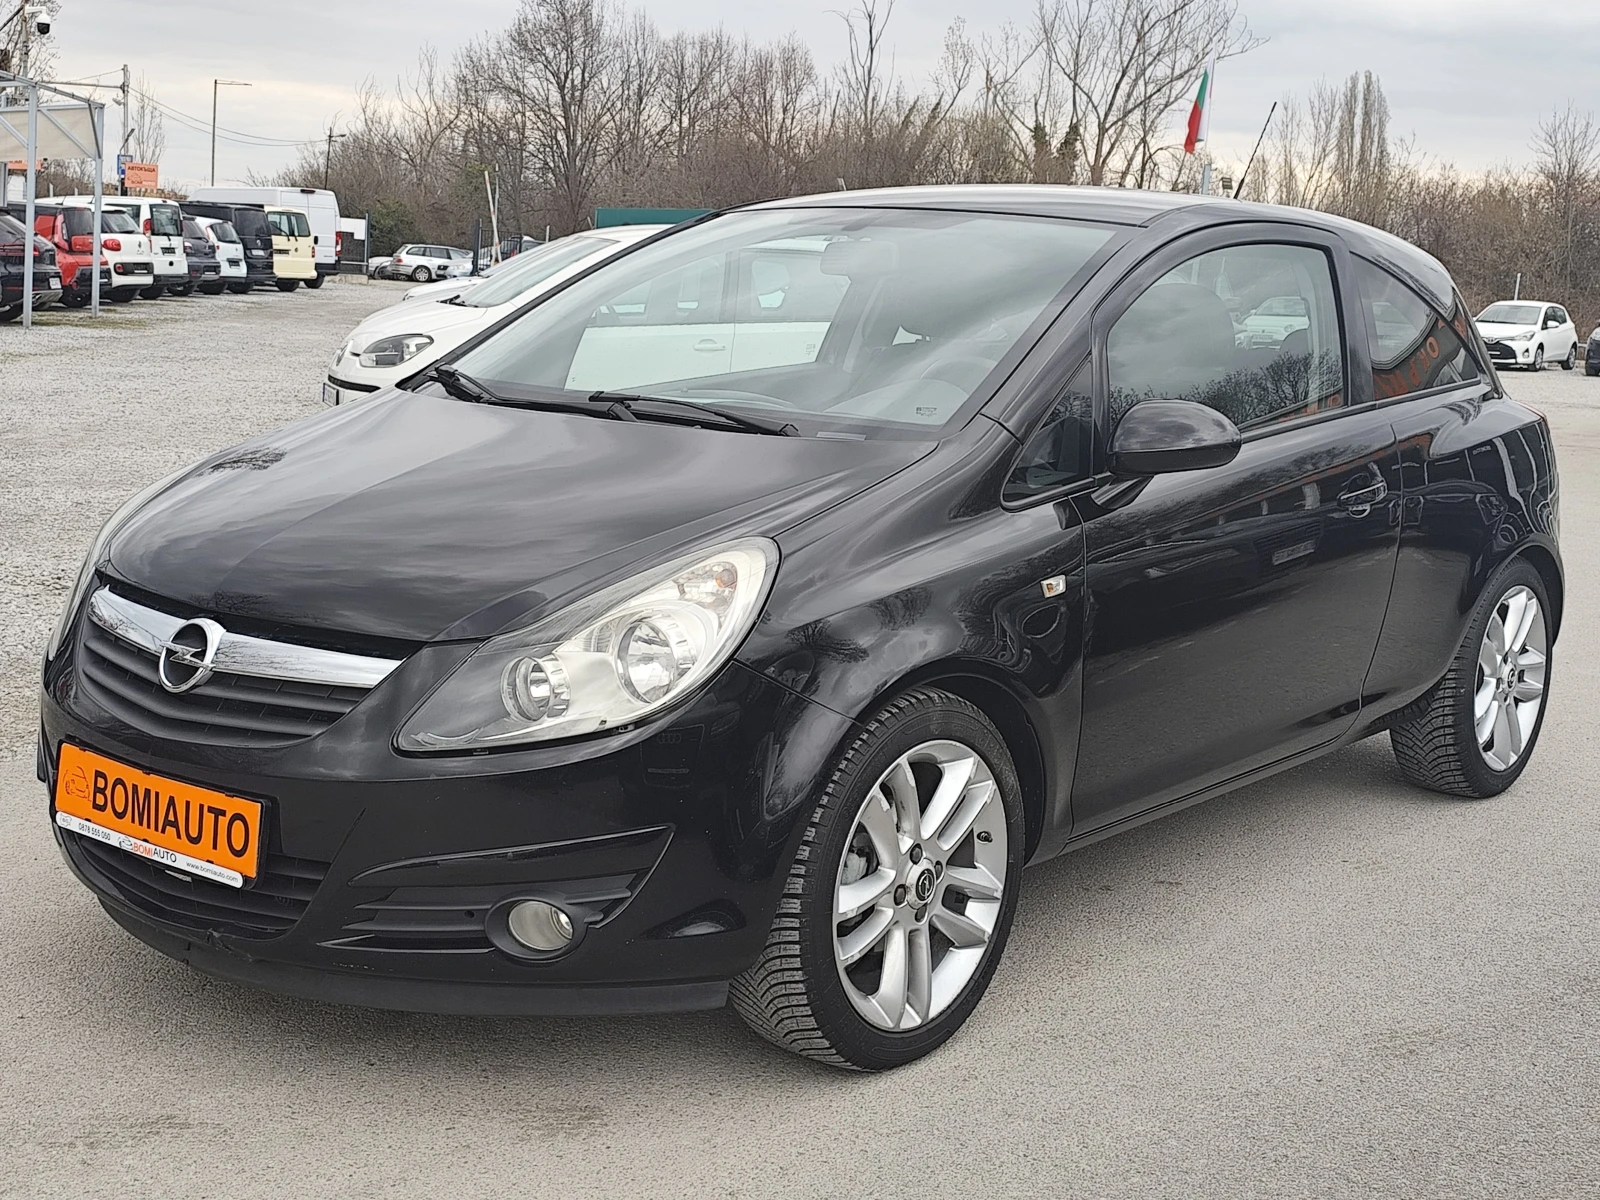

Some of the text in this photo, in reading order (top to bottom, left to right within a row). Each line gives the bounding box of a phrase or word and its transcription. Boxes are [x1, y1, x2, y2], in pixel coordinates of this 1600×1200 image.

[93, 770, 250, 857] BOMIAUTO
[79, 823, 91, 834] 0878
[92, 827, 101, 837] 555
[133, 842, 177, 863] BOMIAUTO
[186, 861, 239, 883] www.bomiauto.com
